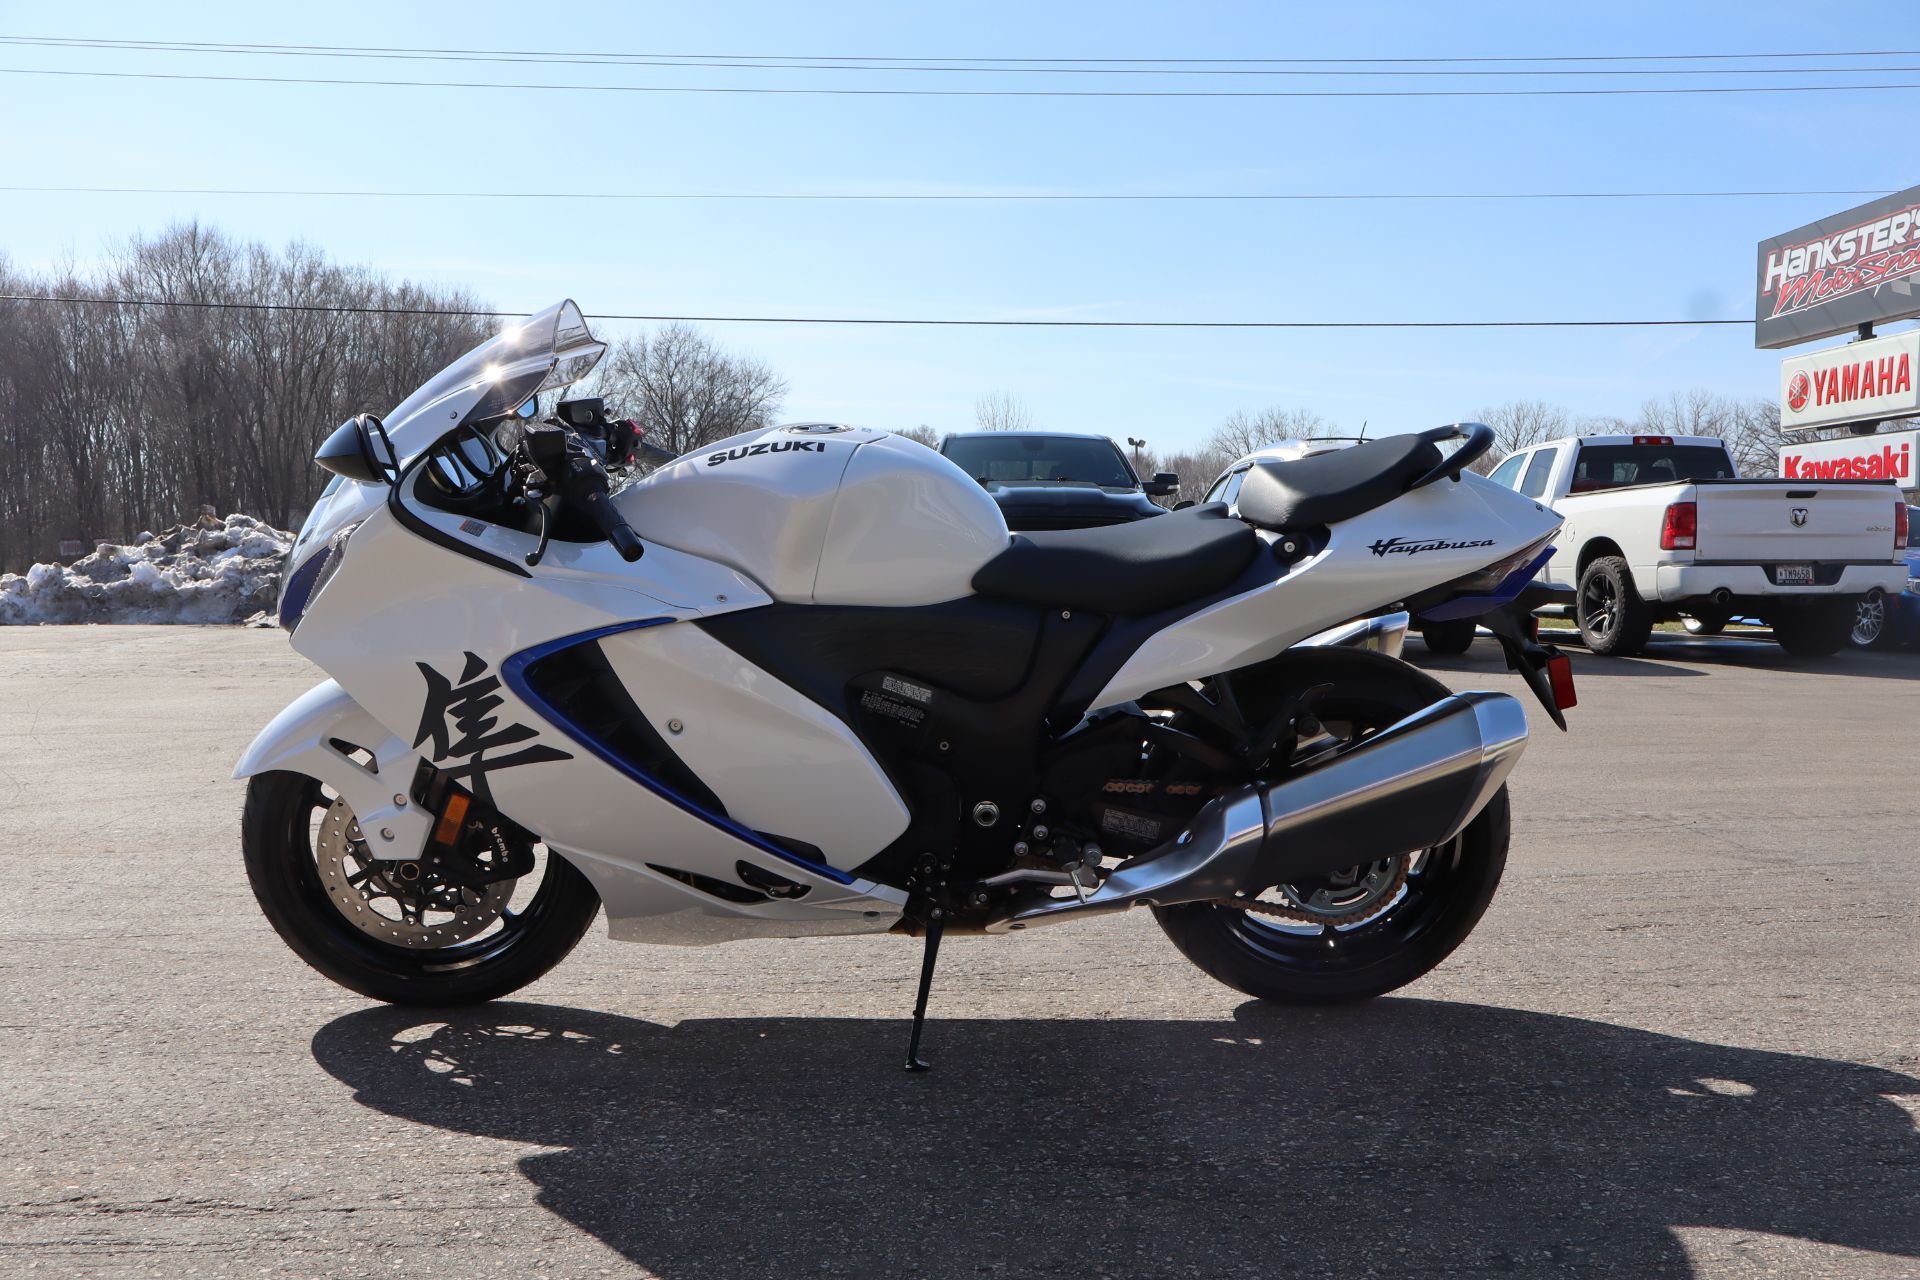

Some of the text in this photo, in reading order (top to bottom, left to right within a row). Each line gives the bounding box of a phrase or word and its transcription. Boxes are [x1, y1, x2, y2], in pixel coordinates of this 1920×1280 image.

[1772, 246, 1920, 317] MotorSpo
[1814, 352, 1910, 406] YAMAHA
[708, 441, 825, 467] SUZUKI
[1784, 443, 1909, 480] Kawasaki
[1367, 536, 1496, 558] Hayabusa
[491, 827, 509, 862] brembo
